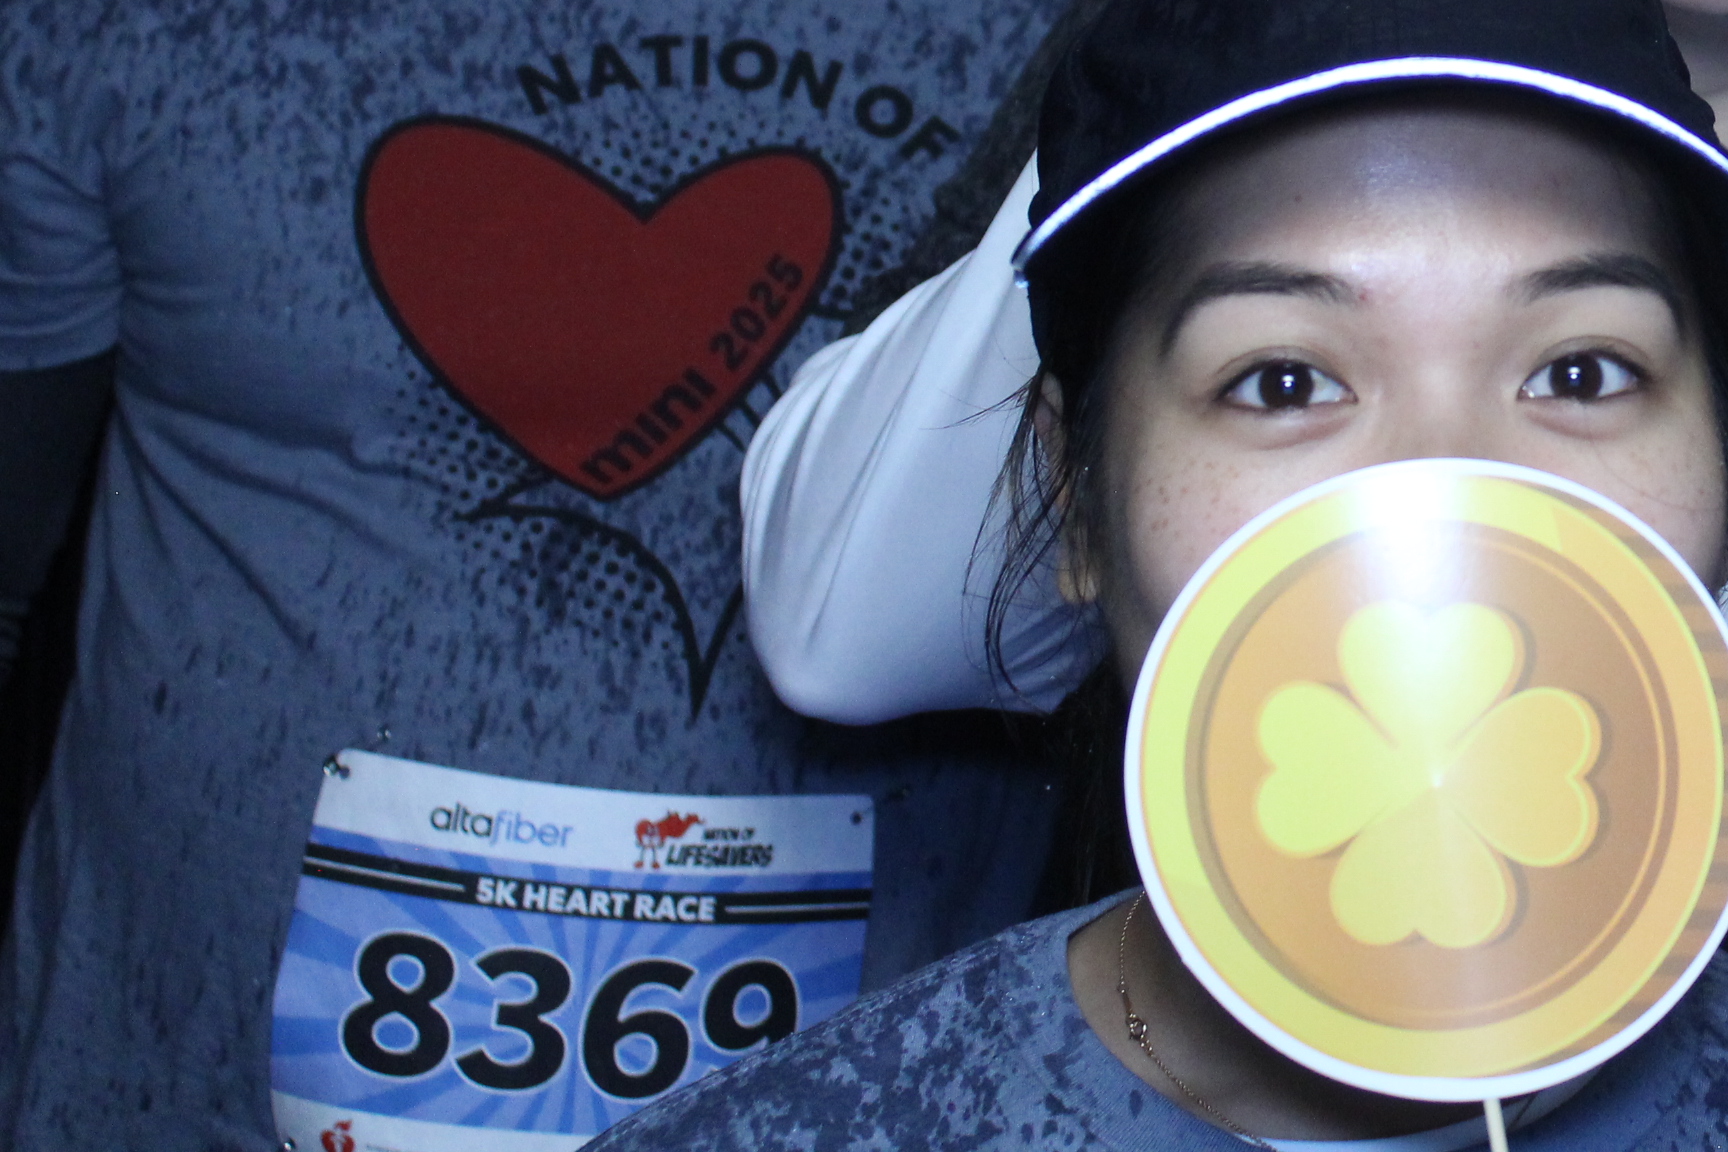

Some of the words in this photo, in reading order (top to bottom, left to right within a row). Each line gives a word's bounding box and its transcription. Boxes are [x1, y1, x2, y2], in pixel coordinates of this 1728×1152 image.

[514, 34, 844, 116] NATION
[855, 84, 961, 161] OF
[579, 367, 716, 484] mini
[708, 252, 803, 371] 2025
[429, 800, 574, 847] altafiber
[665, 843, 774, 869] LIFESAVERS
[475, 876, 518, 908] 5K
[522, 881, 630, 919] HEART
[632, 894, 718, 923] RACE
[339, 930, 799, 1101] 8369
